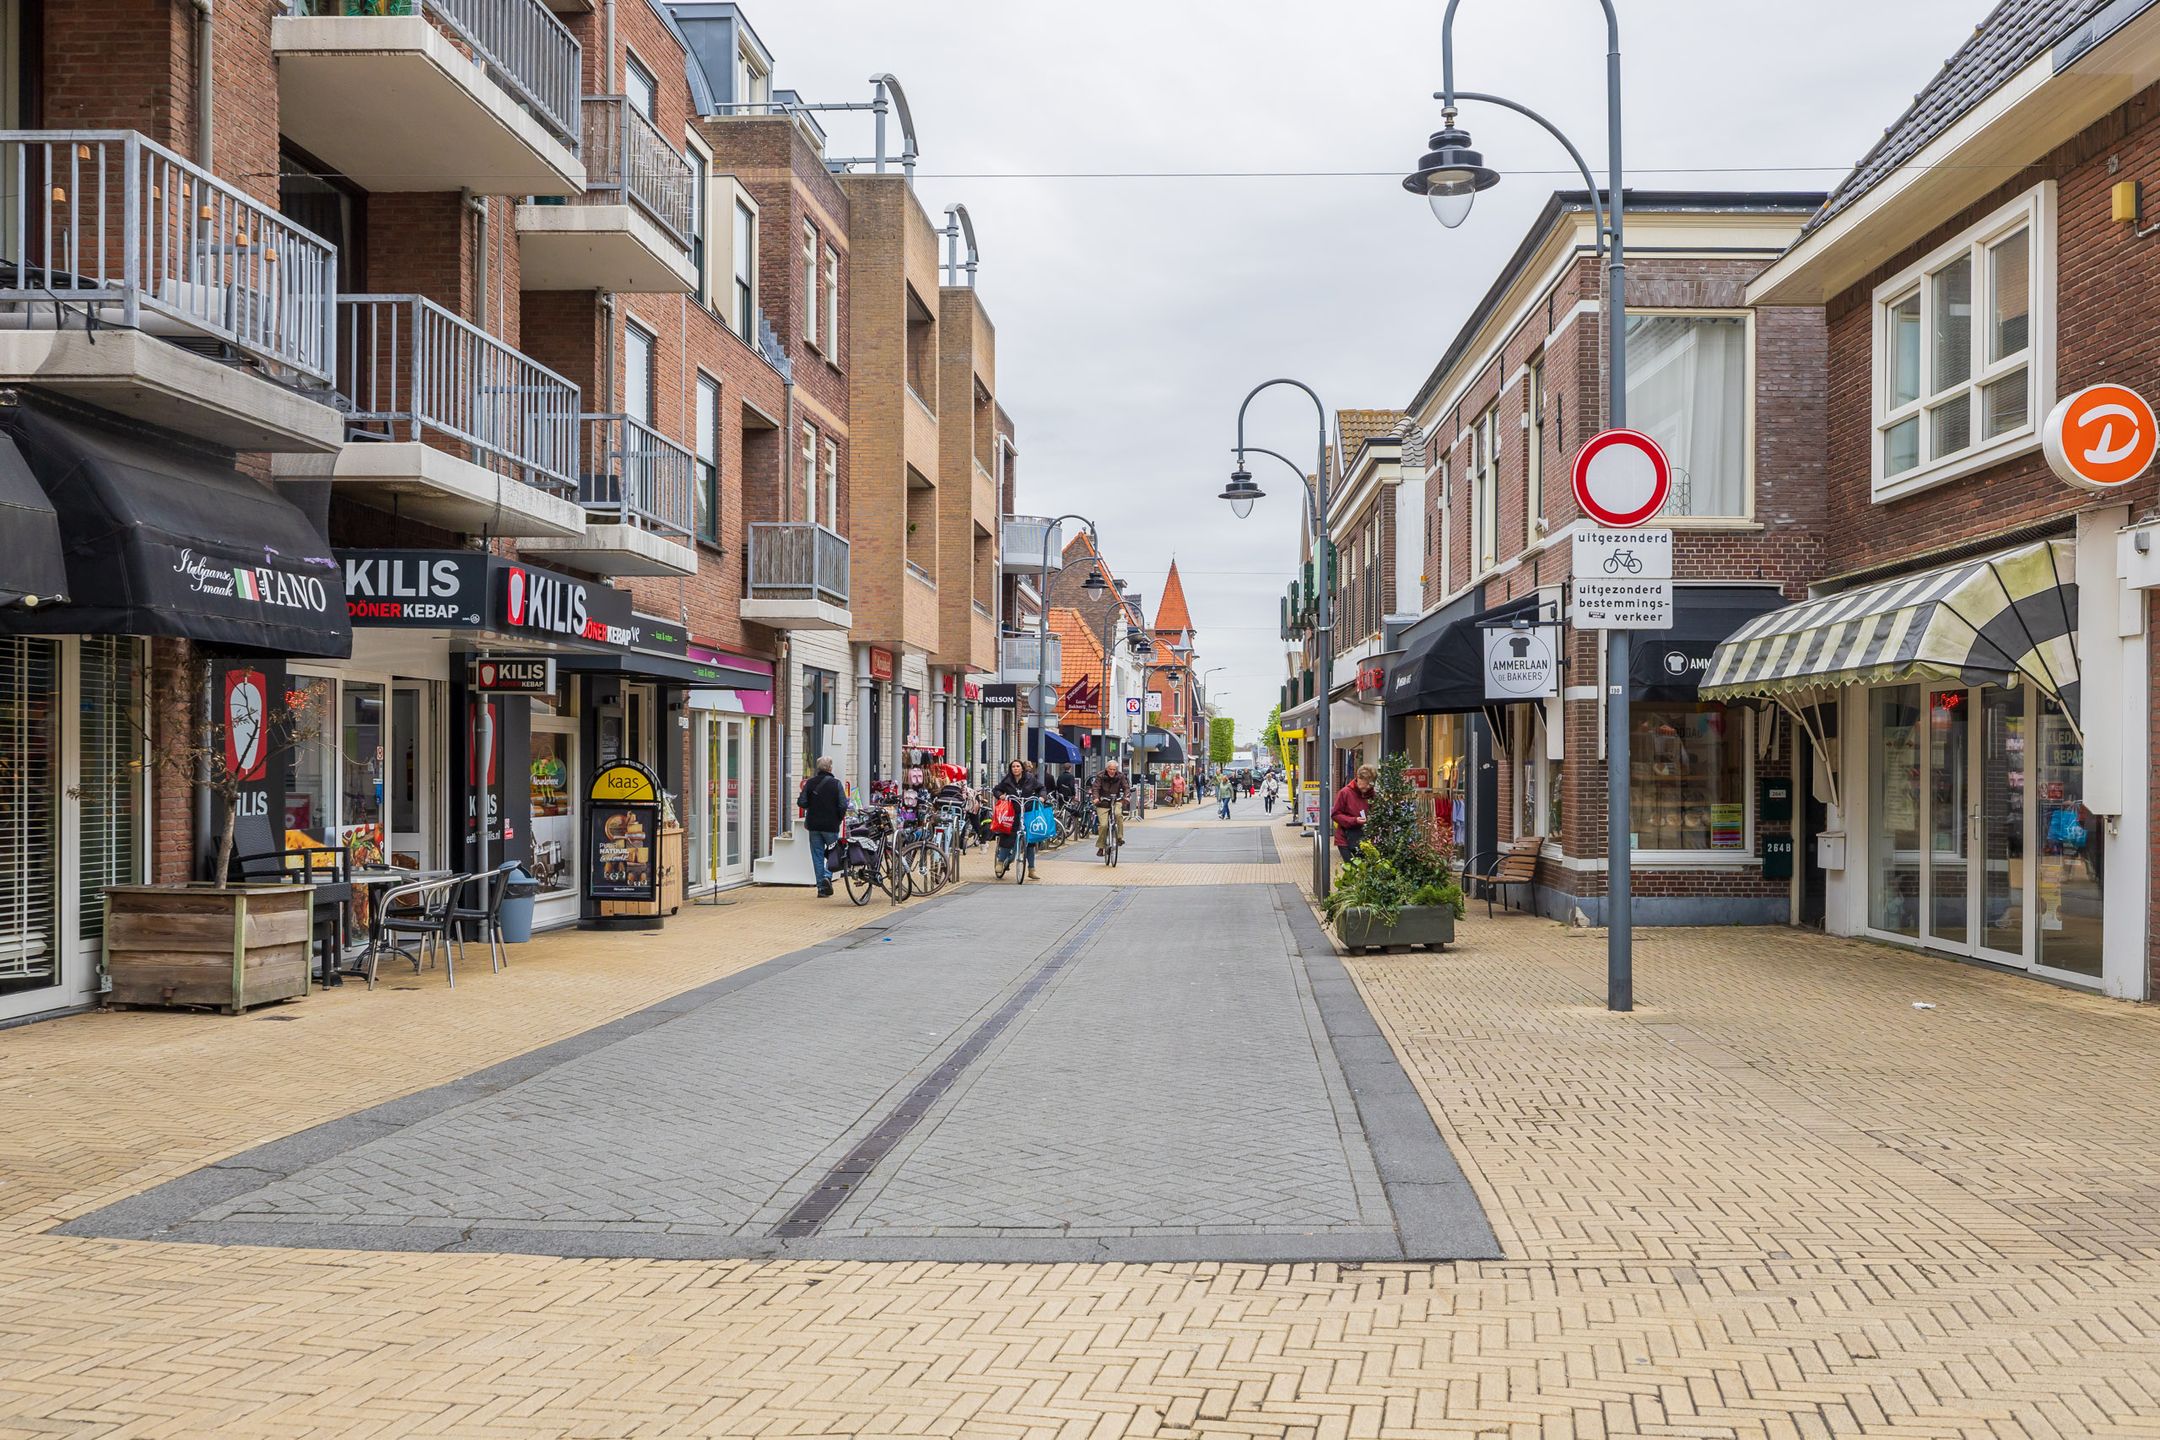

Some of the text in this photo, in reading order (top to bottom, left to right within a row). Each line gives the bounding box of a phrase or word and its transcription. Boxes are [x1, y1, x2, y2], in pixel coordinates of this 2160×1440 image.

[1578, 533, 1668, 546] uitgezonderd
[345, 559, 461, 597] KILIS
[256, 567, 327, 613] TANO
[1580, 585, 1662, 597] uitgezonderd
[403, 603, 459, 618] KEBAP
[528, 574, 587, 635] KILIS
[1580, 598, 1670, 611] bestemmings-
[1615, 613, 1663, 622] verkeer
[607, 625, 631, 647] KEBAP
[499, 664, 544, 679] KILIS
[1493, 660, 1548, 670] AMMERLAAN
[1507, 672, 1543, 681] BAKKERS
[608, 773, 639, 788] kaas
